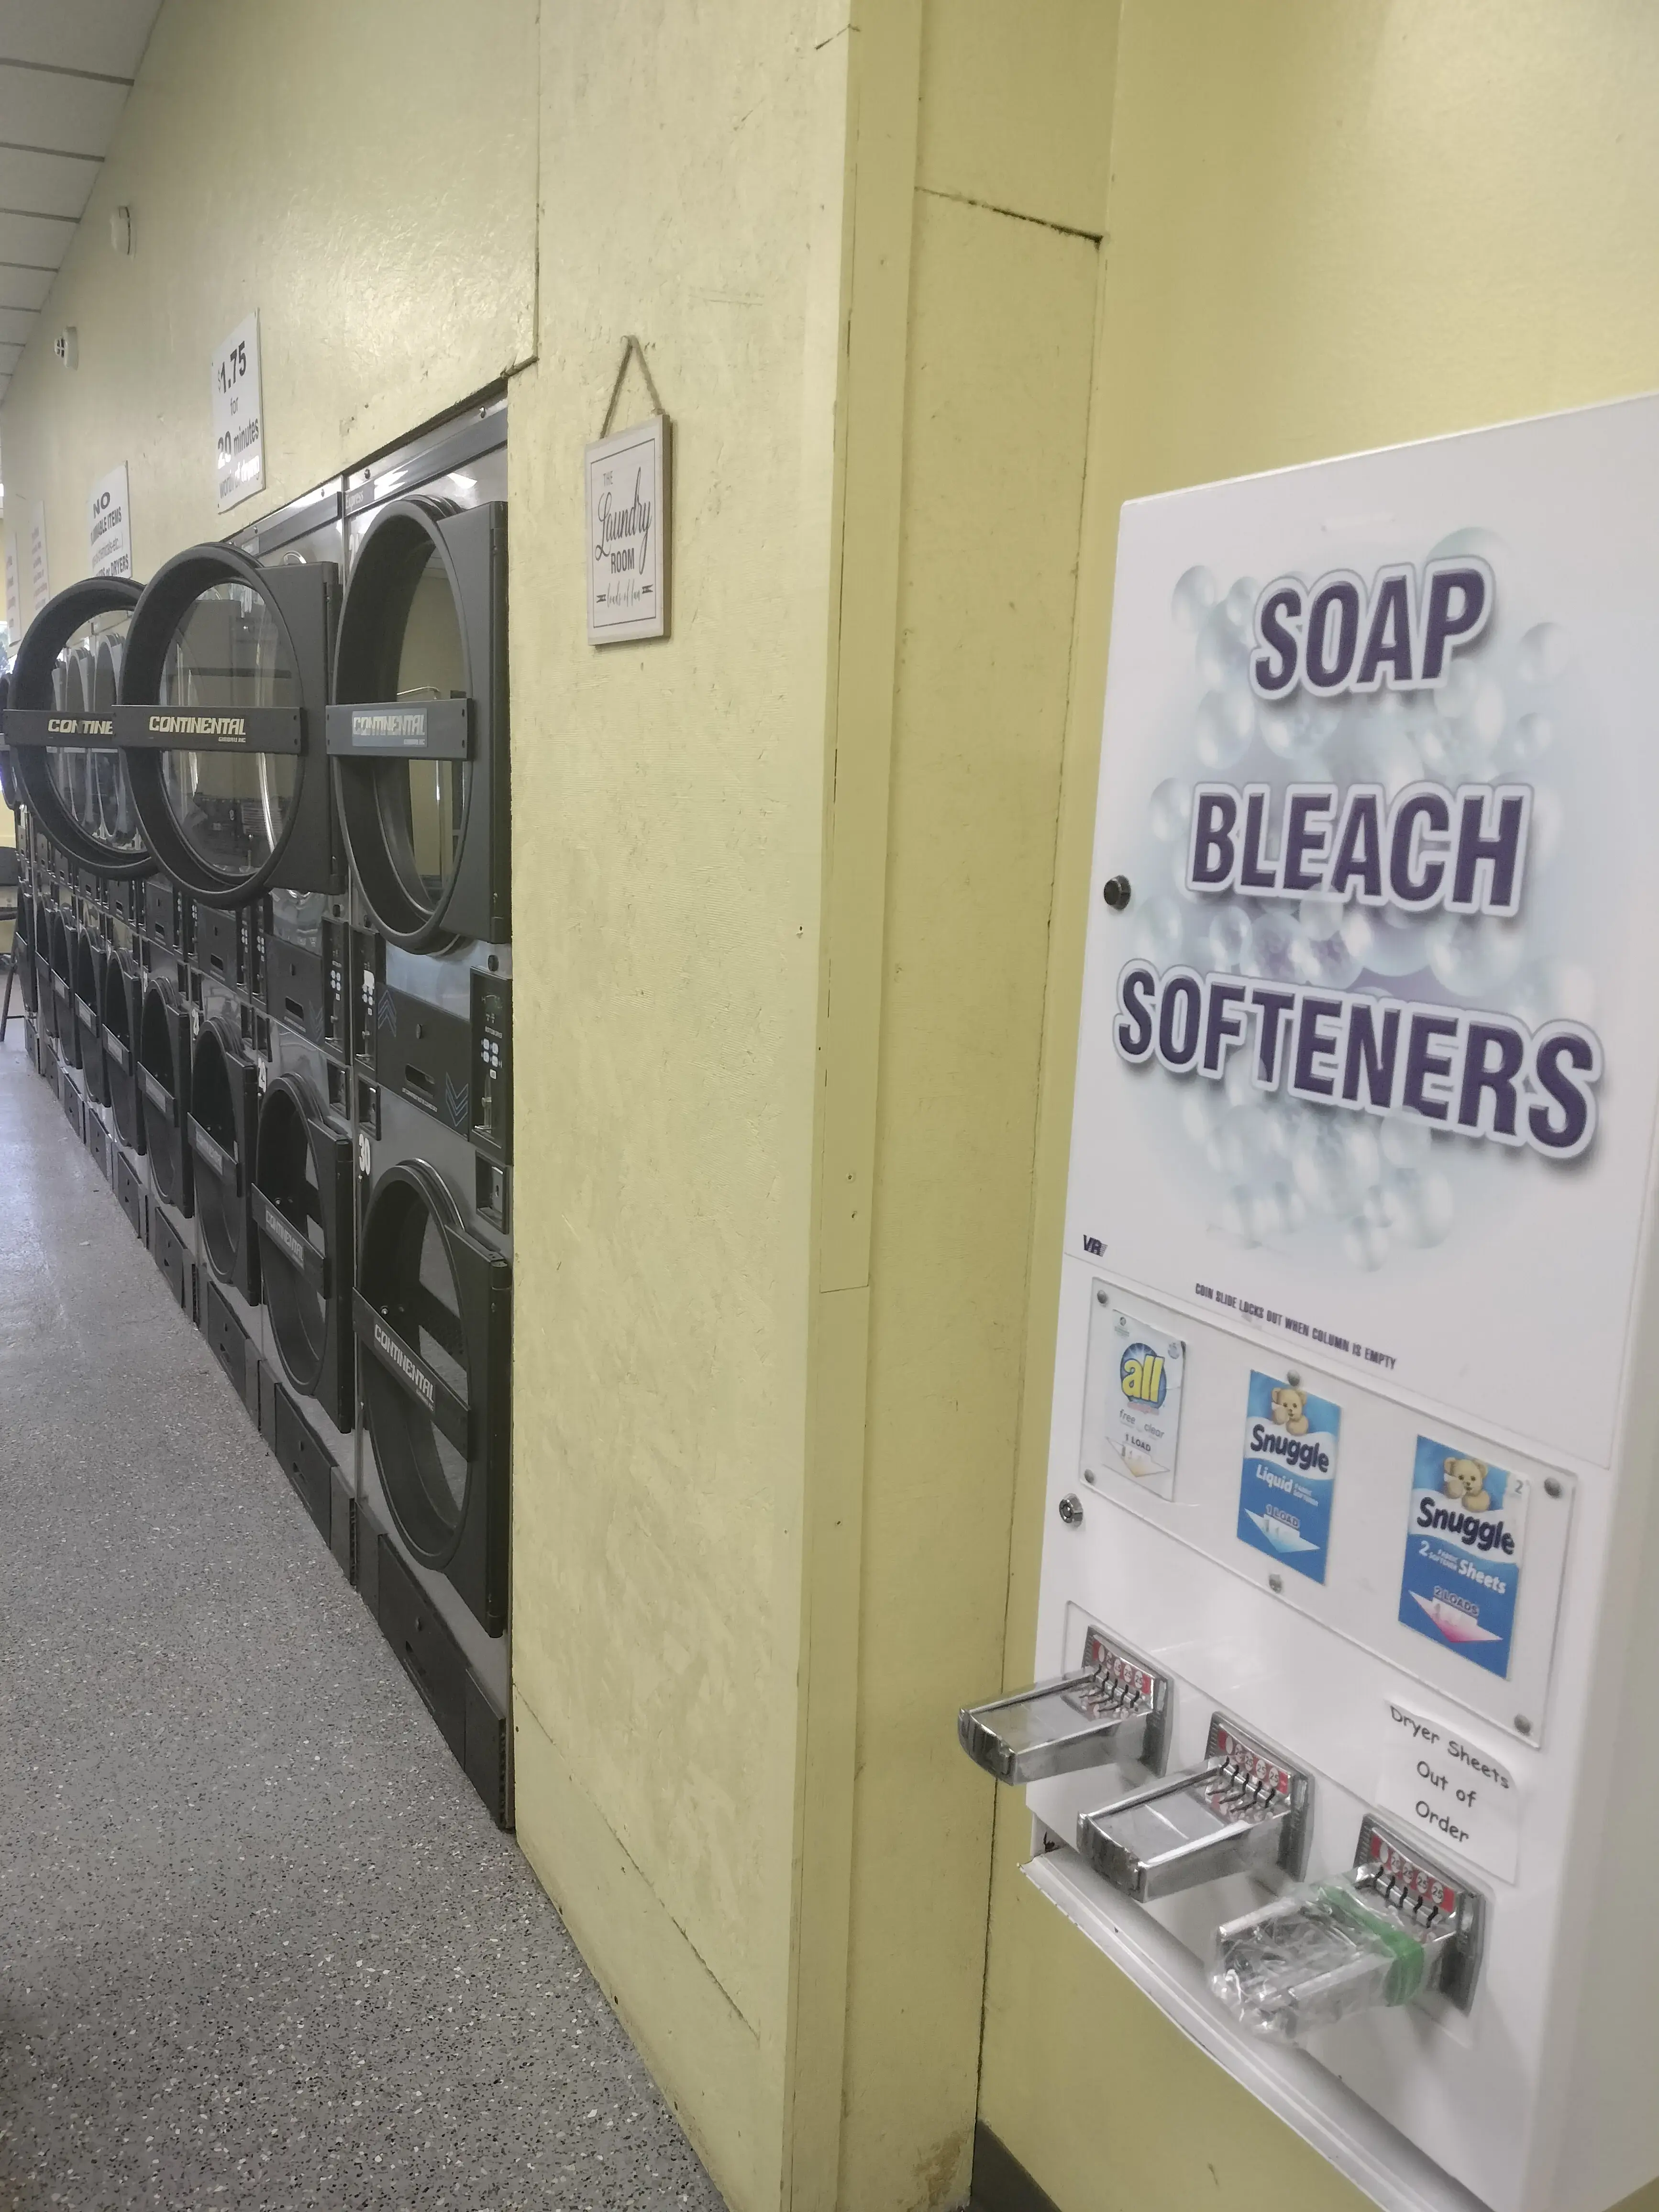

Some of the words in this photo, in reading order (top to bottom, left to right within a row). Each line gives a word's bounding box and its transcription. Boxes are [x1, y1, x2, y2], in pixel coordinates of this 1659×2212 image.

[218, 341, 247, 394] $1.75
[230, 396, 239, 415] for
[217, 431, 232, 469] 20
[233, 418, 259, 457] minutes
[603, 470, 613, 487] THE
[93, 492, 111, 519] NO
[108, 506, 122, 530] ITEMS
[595, 466, 653, 575] Laundry
[111, 553, 129, 578] DRYERS
[611, 547, 635, 574] ROOM
[1253, 565, 1488, 694] SOAP
[149, 716, 246, 735] CONTINENTAL
[353, 715, 425, 736] CONTINENTAL
[1190, 789, 1526, 909] BLEACH
[1116, 966, 1597, 1151] SOFTENERS
[359, 1133, 371, 1175] 30
[1195, 1283, 1215, 1299] COIN
[1216, 1290, 1238, 1309] SLIDE
[1239, 1299, 1264, 1319] LOCKS
[1266, 1309, 1283, 1326] OUT
[1285, 1316, 1310, 1337] WHEN
[1312, 1327, 1349, 1352] COLUMN
[1352, 1342, 1362, 1357] IS
[1364, 1347, 1397, 1370] EMPTY
[374, 1324, 434, 1404] CONTINENTAL
[1121, 1353, 1165, 1404] all
[1119, 1408, 1136, 1425] free
[1144, 1423, 1165, 1439] clear
[1126, 1433, 1129, 1442] 1
[1131, 1435, 1151, 1452] LOAD
[1250, 1424, 1329, 1473] Snuggle
[1256, 1463, 1293, 1493] Liquid
[1273, 1508, 1300, 1528] LOAD
[1416, 1496, 1515, 1555] Snuggle
[1418, 1540, 1430, 1556] 2
[1458, 1559, 1506, 1594] Sheets
[1435, 1586, 1441, 1597] 2
[1443, 1590, 1479, 1615] LOADS
[1390, 1705, 1440, 1744] Dryer
[1447, 1740, 1510, 1789] Sheets
[1416, 1760, 1449, 1791] Out
[1456, 1789, 1477, 1808] of
[1415, 1800, 1469, 1843] Order
